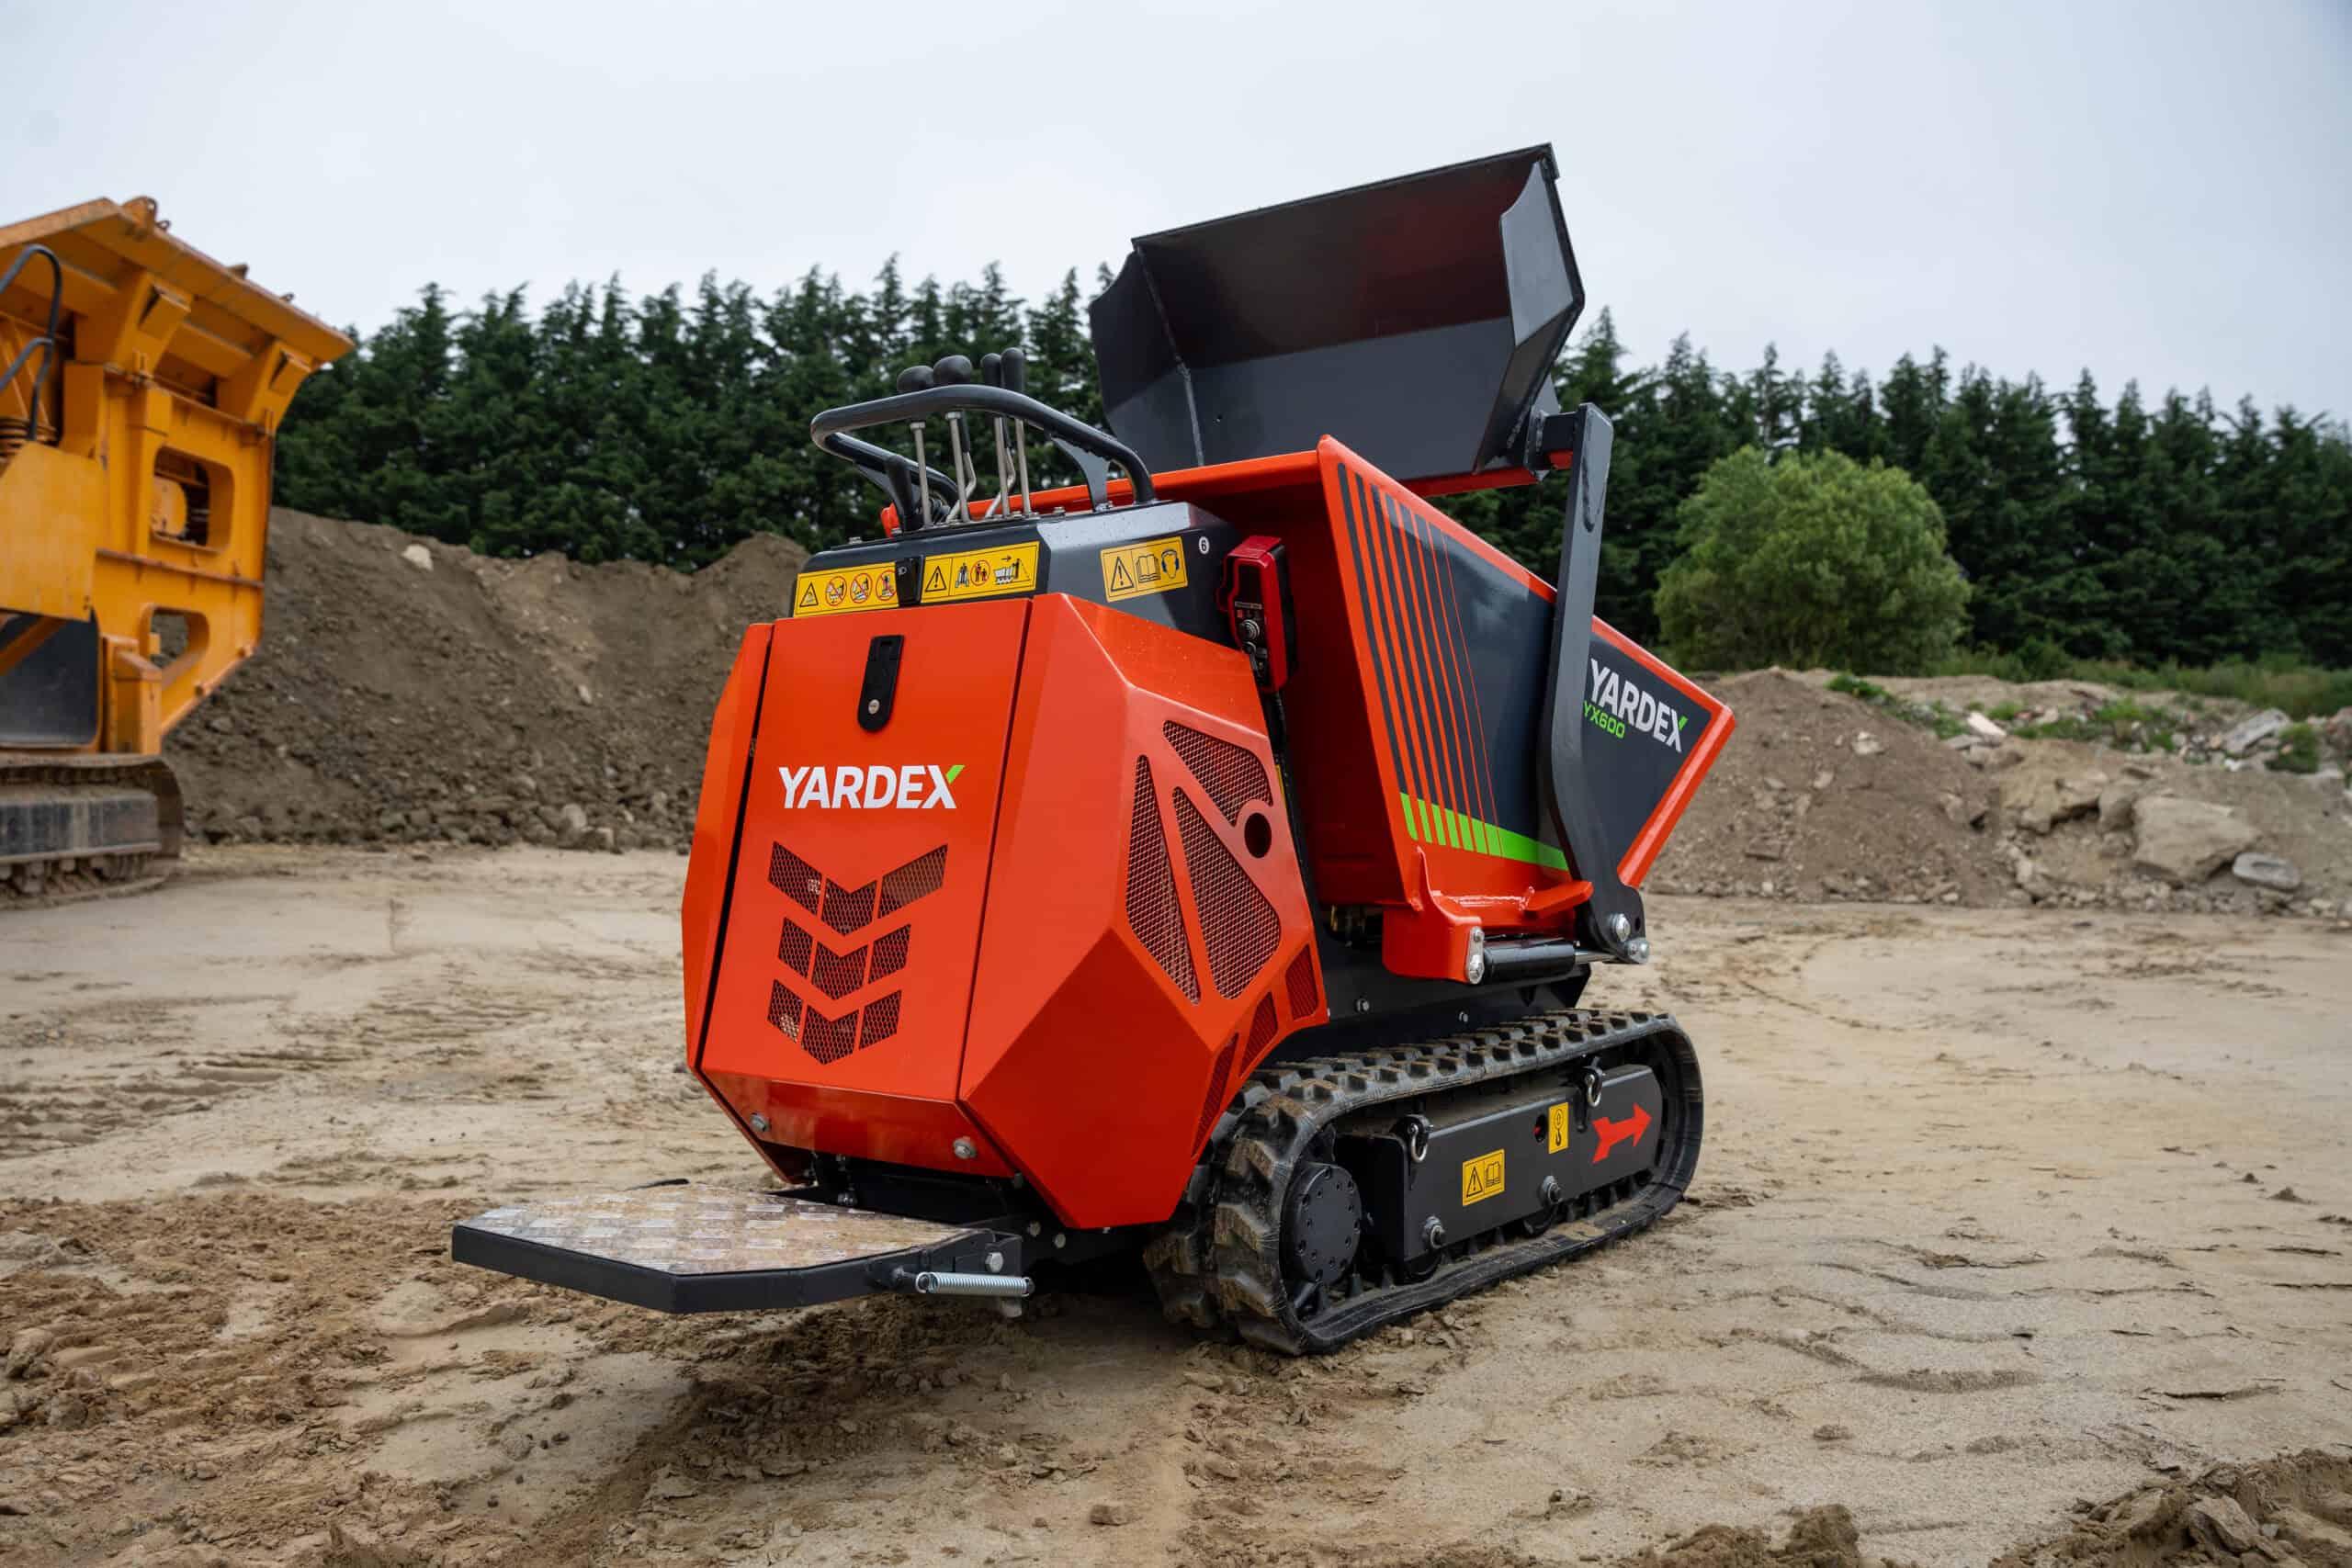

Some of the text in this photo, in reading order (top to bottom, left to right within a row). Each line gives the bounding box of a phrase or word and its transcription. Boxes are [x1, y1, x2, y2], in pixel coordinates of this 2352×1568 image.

[1583, 701, 1626, 739] YX600
[1590, 659, 1689, 753] YARDEX
[779, 764, 966, 809] YARDEX
